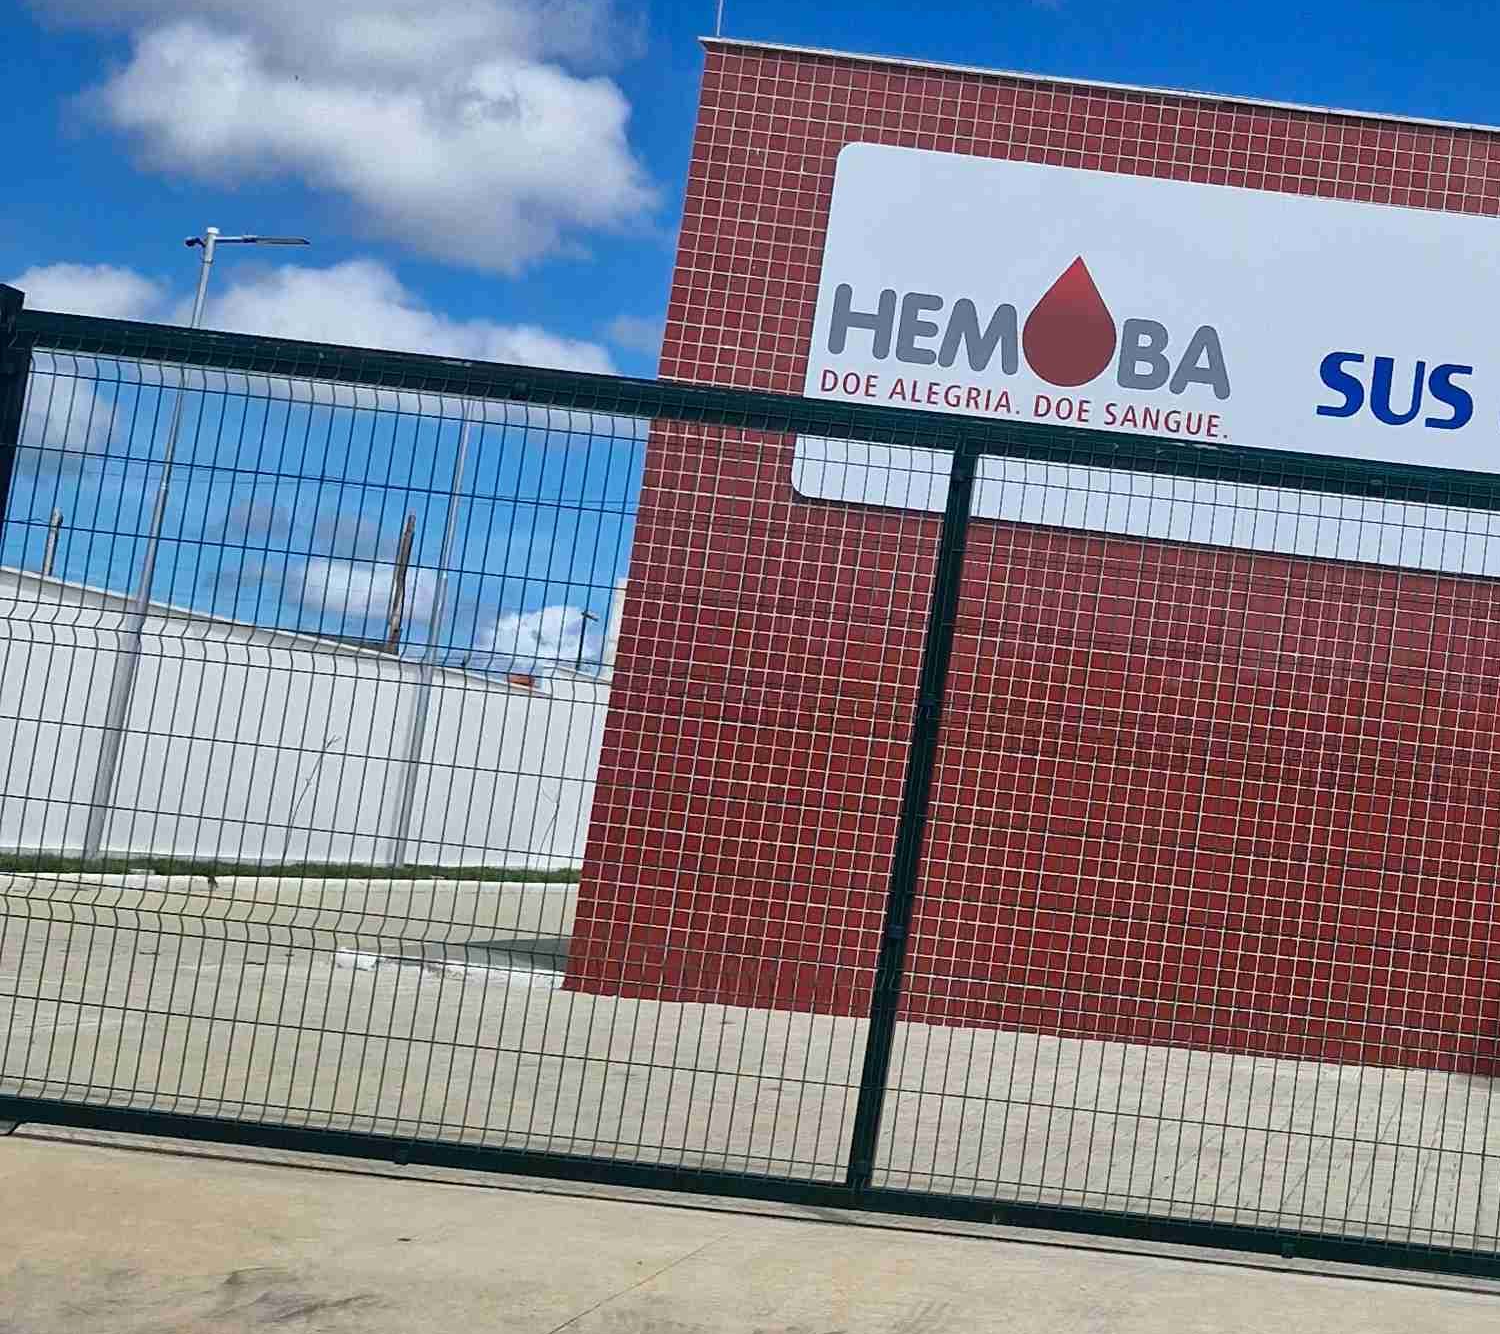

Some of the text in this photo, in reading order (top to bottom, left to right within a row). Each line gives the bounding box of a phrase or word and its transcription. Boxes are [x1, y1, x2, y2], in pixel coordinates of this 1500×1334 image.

[820, 369, 1228, 439] DOE ALEGRIA. DOE SANGUE.
[1316, 351, 1474, 430] SUS
